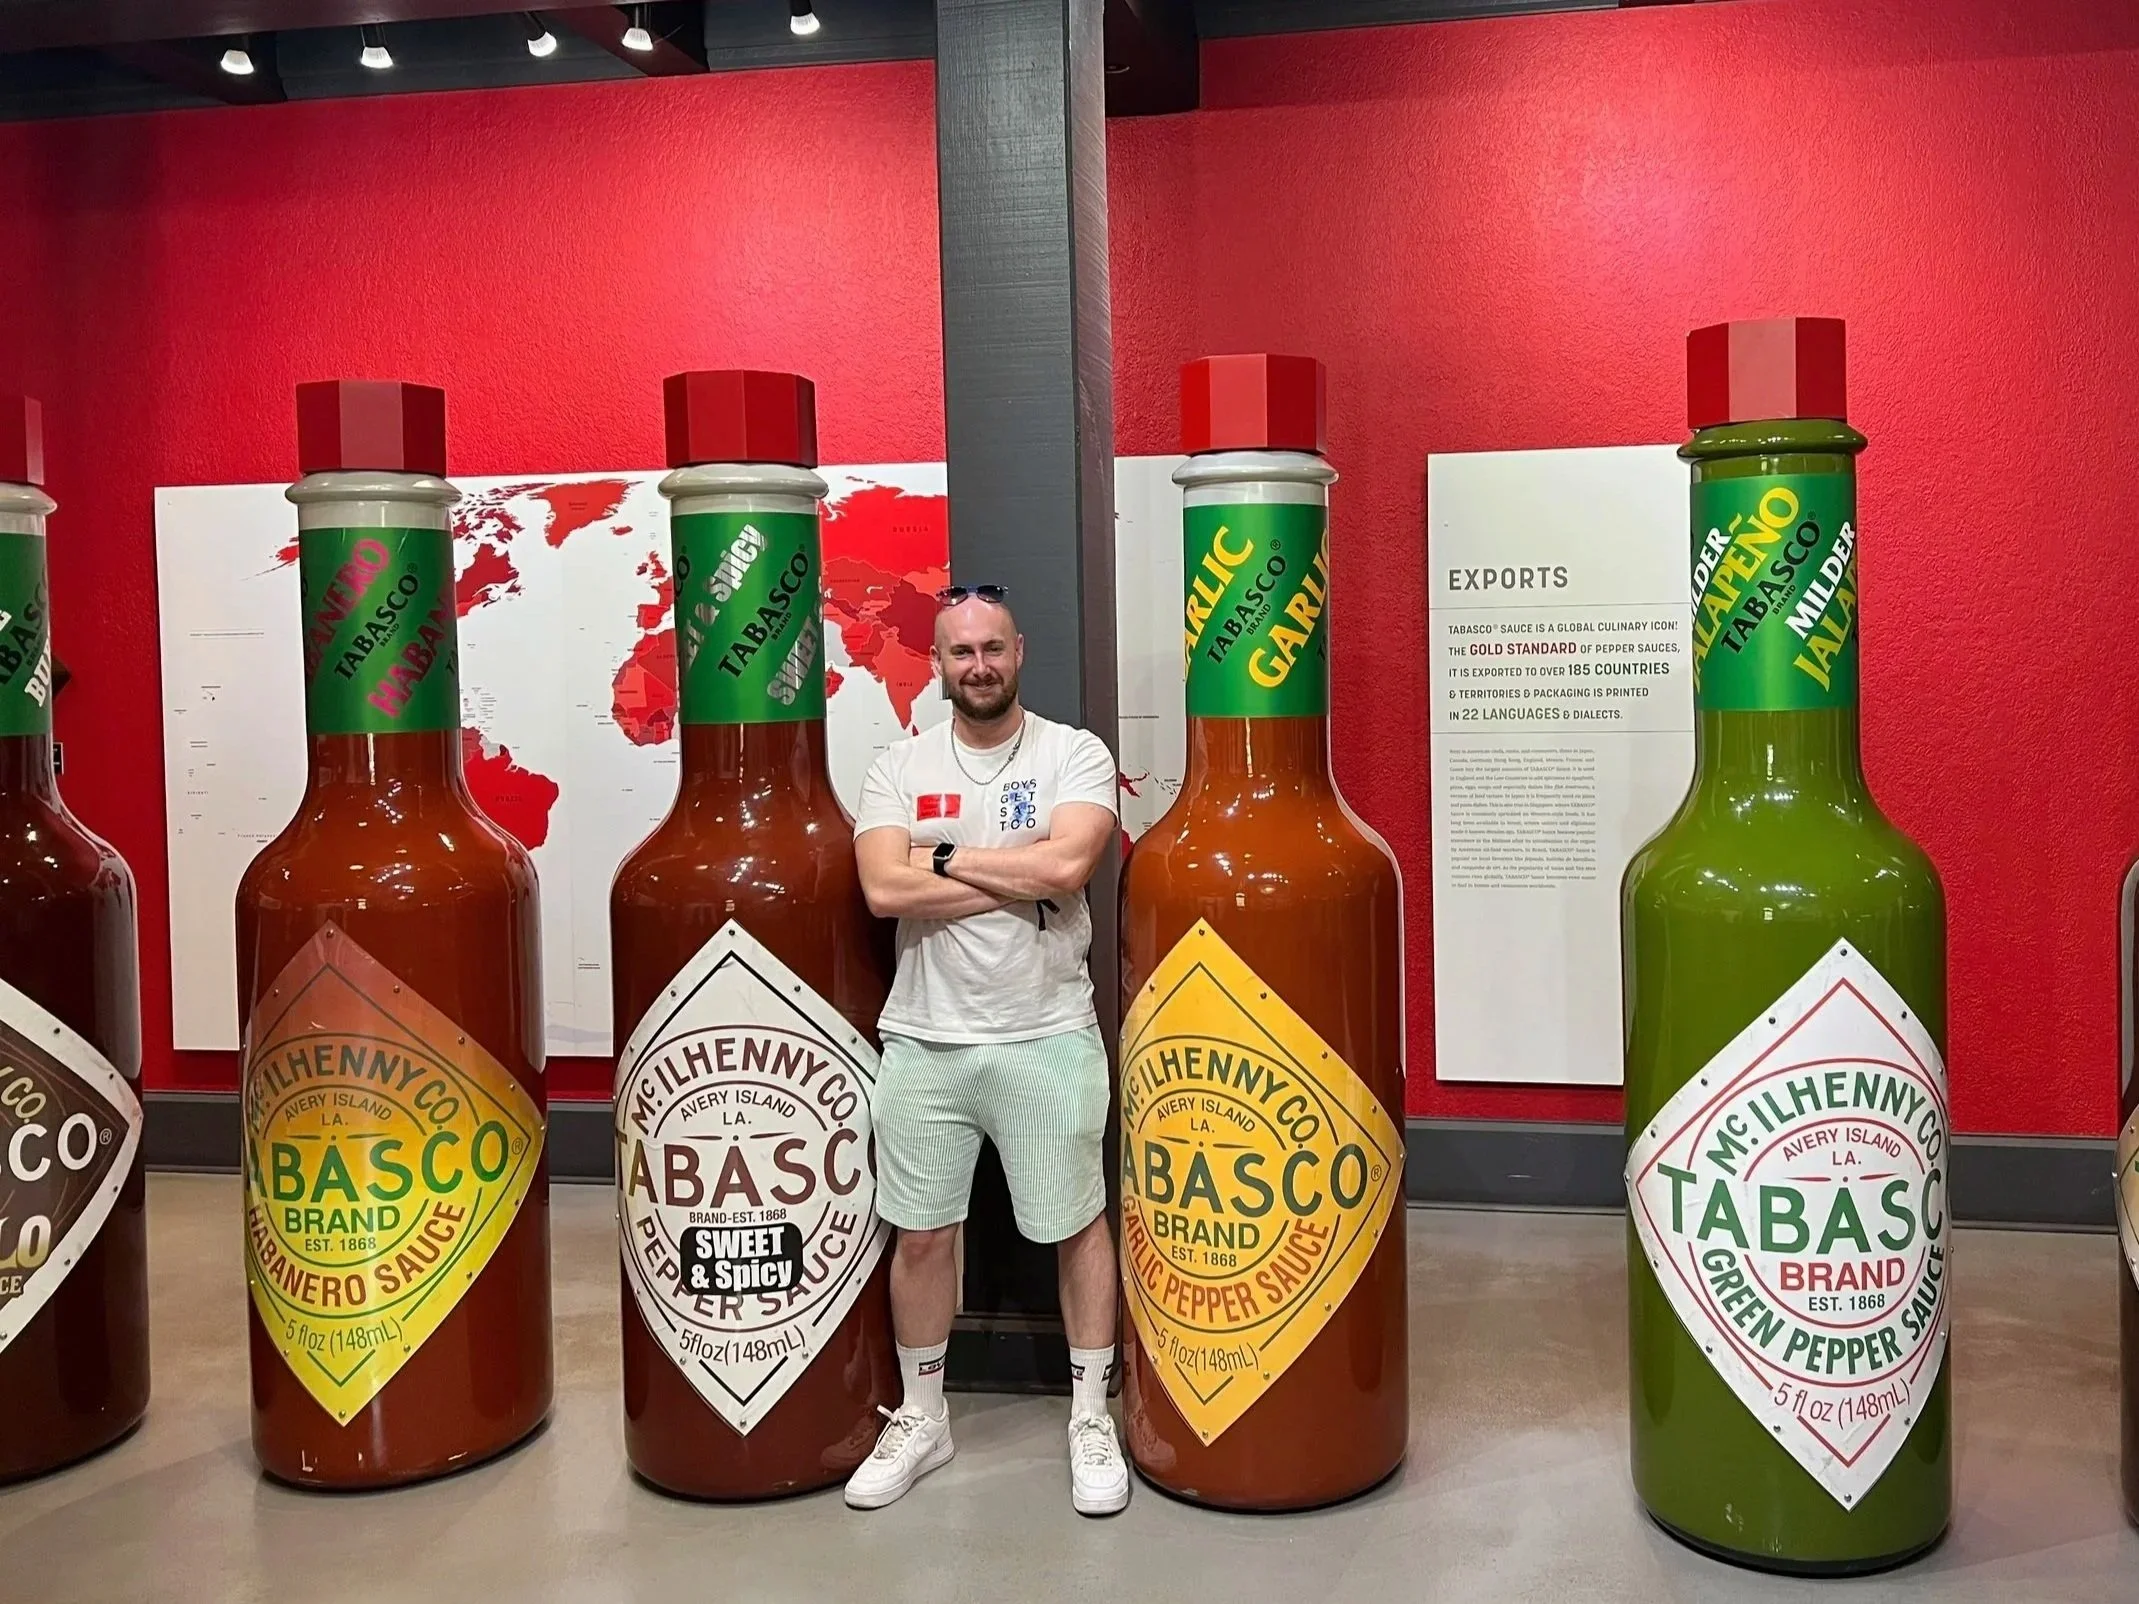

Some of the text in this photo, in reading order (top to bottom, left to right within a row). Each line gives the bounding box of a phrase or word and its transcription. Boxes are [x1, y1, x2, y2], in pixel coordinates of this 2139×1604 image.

[1449, 566, 1569, 591] EXPORTS
[1785, 521, 1855, 640] MILDER
[1184, 526, 1254, 675] ARLIC
[1772, 584, 1796, 615] BRAND
[771, 612, 792, 641] BRAND
[1246, 603, 1271, 635] BRAND
[1500, 623, 1533, 634] SAUCE
[1535, 623, 1546, 633] IS
[1548, 623, 1555, 633] A
[1557, 622, 1595, 633] GLOBAL
[1597, 621, 1648, 632] CULINARY
[1650, 620, 1678, 631] ICON!
[379, 622, 400, 647] BRAND
[1449, 641, 1681, 656] THE GOLD STANDARD OF PEPPER SAUCES,
[1449, 662, 1670, 678] IT IS EXPORTED TO OVER 185 COUNTRIES
[1449, 687, 1649, 699] & TERRITORIES & PACKAGING IS PRINTED
[1449, 707, 1624, 721] IN 22 LANGUAGES & DIALECTS.
[1000, 791, 1036, 804] GET
[1003, 779, 1037, 791] BOYS
[1000, 804, 1036, 818] SAD
[1000, 817, 1036, 832] TOO
[284, 1092, 393, 1122] AVERY ISLAND
[680, 1089, 797, 1122] AVERY ISLAND
[1156, 1096, 1257, 1134] AVERY ISLAND
[322, 1113, 349, 1127] LA.
[723, 1111, 752, 1126] LA.
[1190, 1117, 1215, 1133] LA.
[1781, 1127, 1902, 1163] AVERY ISLAND
[615, 1127, 878, 1209] TABASC
[1831, 1150, 1862, 1166] LA.
[284, 1205, 401, 1234] BRAND
[758, 1207, 788, 1222] 1868
[695, 1225, 785, 1260] SWEET
[1153, 1210, 1260, 1251] BRAND
[249, 1200, 466, 1308] HABANERO SAUCE
[304, 1236, 378, 1253] EST. 1868
[1171, 1245, 1238, 1268] EST. 1868
[757, 1209, 858, 1317] SAUCE
[1122, 1194, 1330, 1324] GARLIC PEPPER SAUCE
[690, 1259, 793, 1292] & Spicy
[1779, 1257, 1906, 1292] BRAND
[1702, 1244, 1945, 1375] GREEN PEPPER SAUCE
[1808, 1293, 1886, 1312] EST. 1868
[285, 1319, 297, 1341] 5
[1157, 1327, 1169, 1350] 5
[1773, 1382, 1789, 1407] 5
[1809, 1400, 1834, 1423] oz
